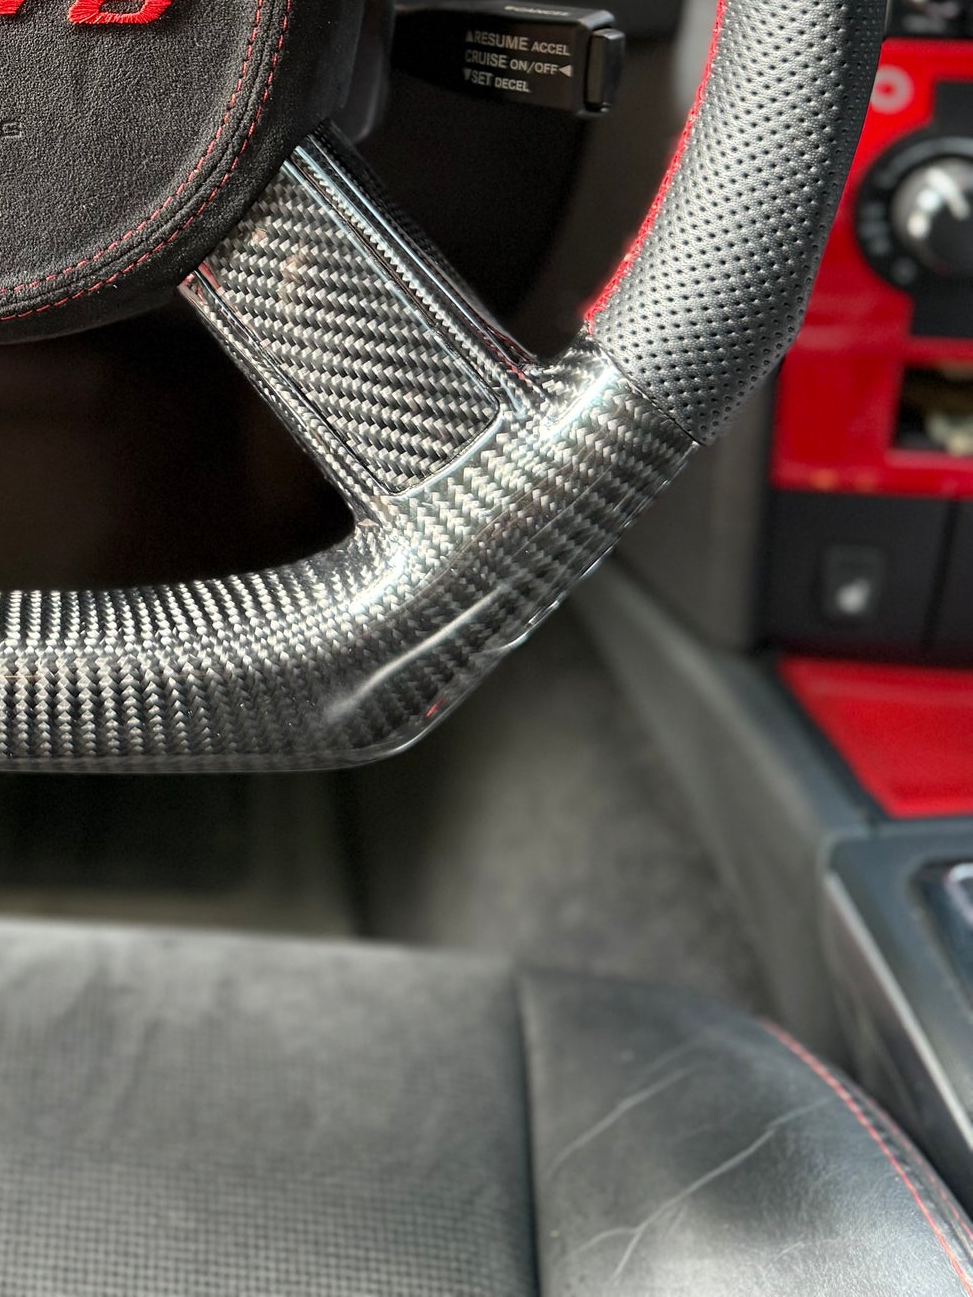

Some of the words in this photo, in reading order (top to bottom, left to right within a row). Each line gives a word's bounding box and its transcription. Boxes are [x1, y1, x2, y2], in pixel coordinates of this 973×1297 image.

[474, 30, 529, 51] RESUME
[531, 41, 571, 56] ACCEL
[465, 49, 507, 69] CRUISE
[509, 58, 559, 75] ON/OFF
[471, 69, 493, 86] SET
[494, 77, 531, 93] DECEL
